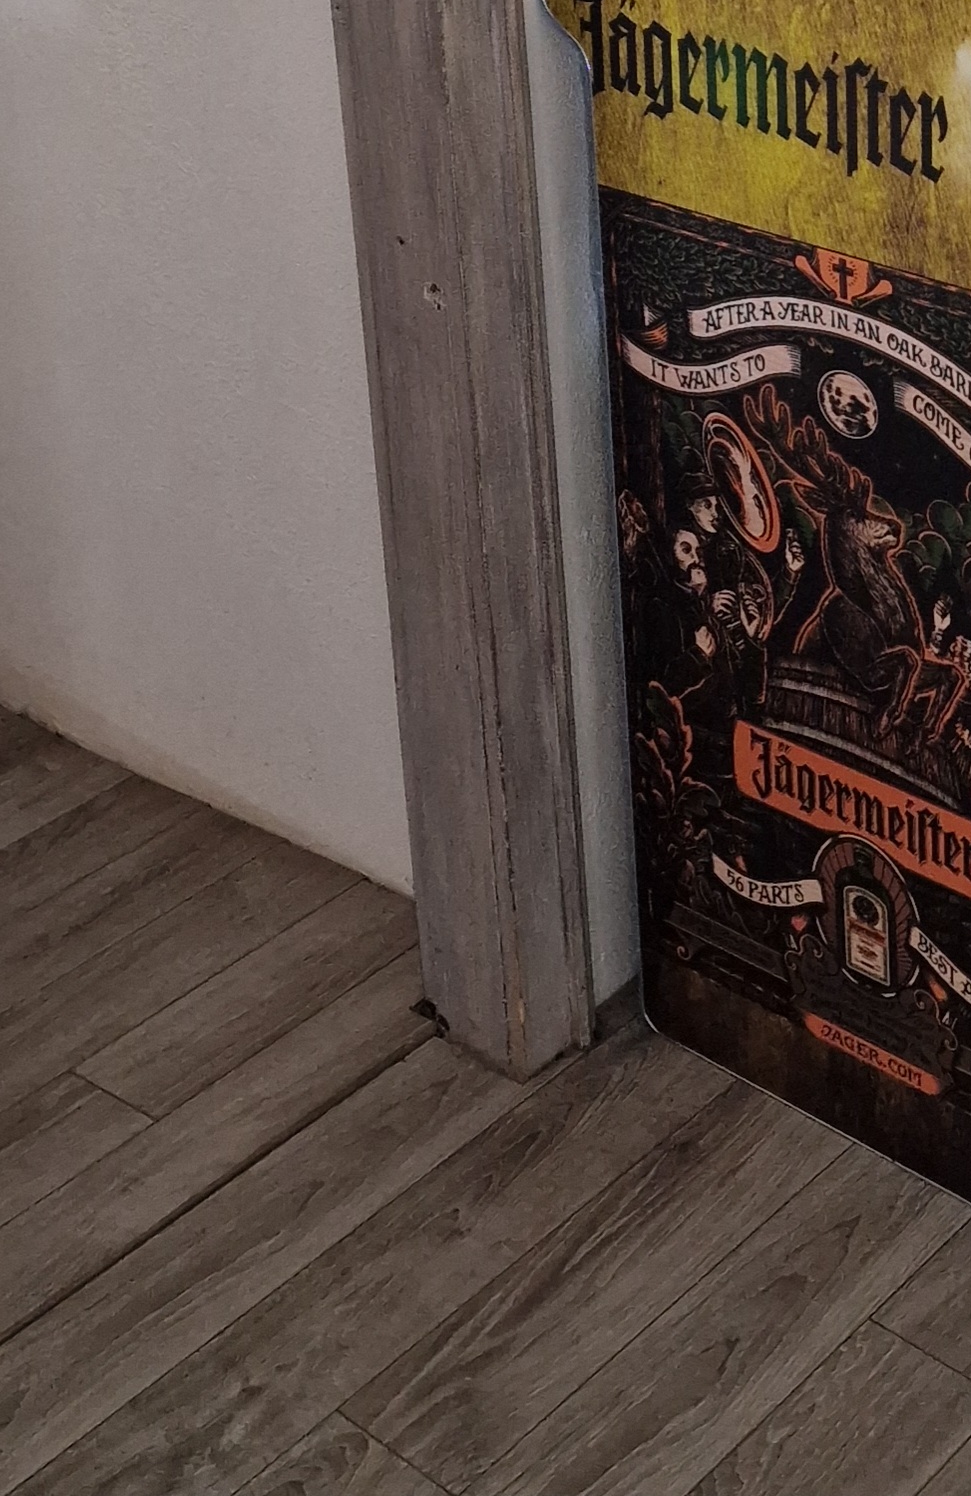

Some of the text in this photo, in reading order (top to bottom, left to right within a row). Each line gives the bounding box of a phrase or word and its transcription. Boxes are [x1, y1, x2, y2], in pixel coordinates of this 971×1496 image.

[703, 303, 761, 333] AFTER
[760, 300, 776, 320] A
[776, 303, 827, 327] YEAR
[830, 312, 851, 332] IN
[852, 318, 881, 342] AN
[887, 333, 928, 367] OAK
[650, 354, 766, 388] IT WANTS TO
[912, 395, 965, 452] COME
[726, 868, 805, 903] 56 PARTS
[918, 930, 959, 985] BEST
[820, 1024, 922, 1087] JAGER.COM
